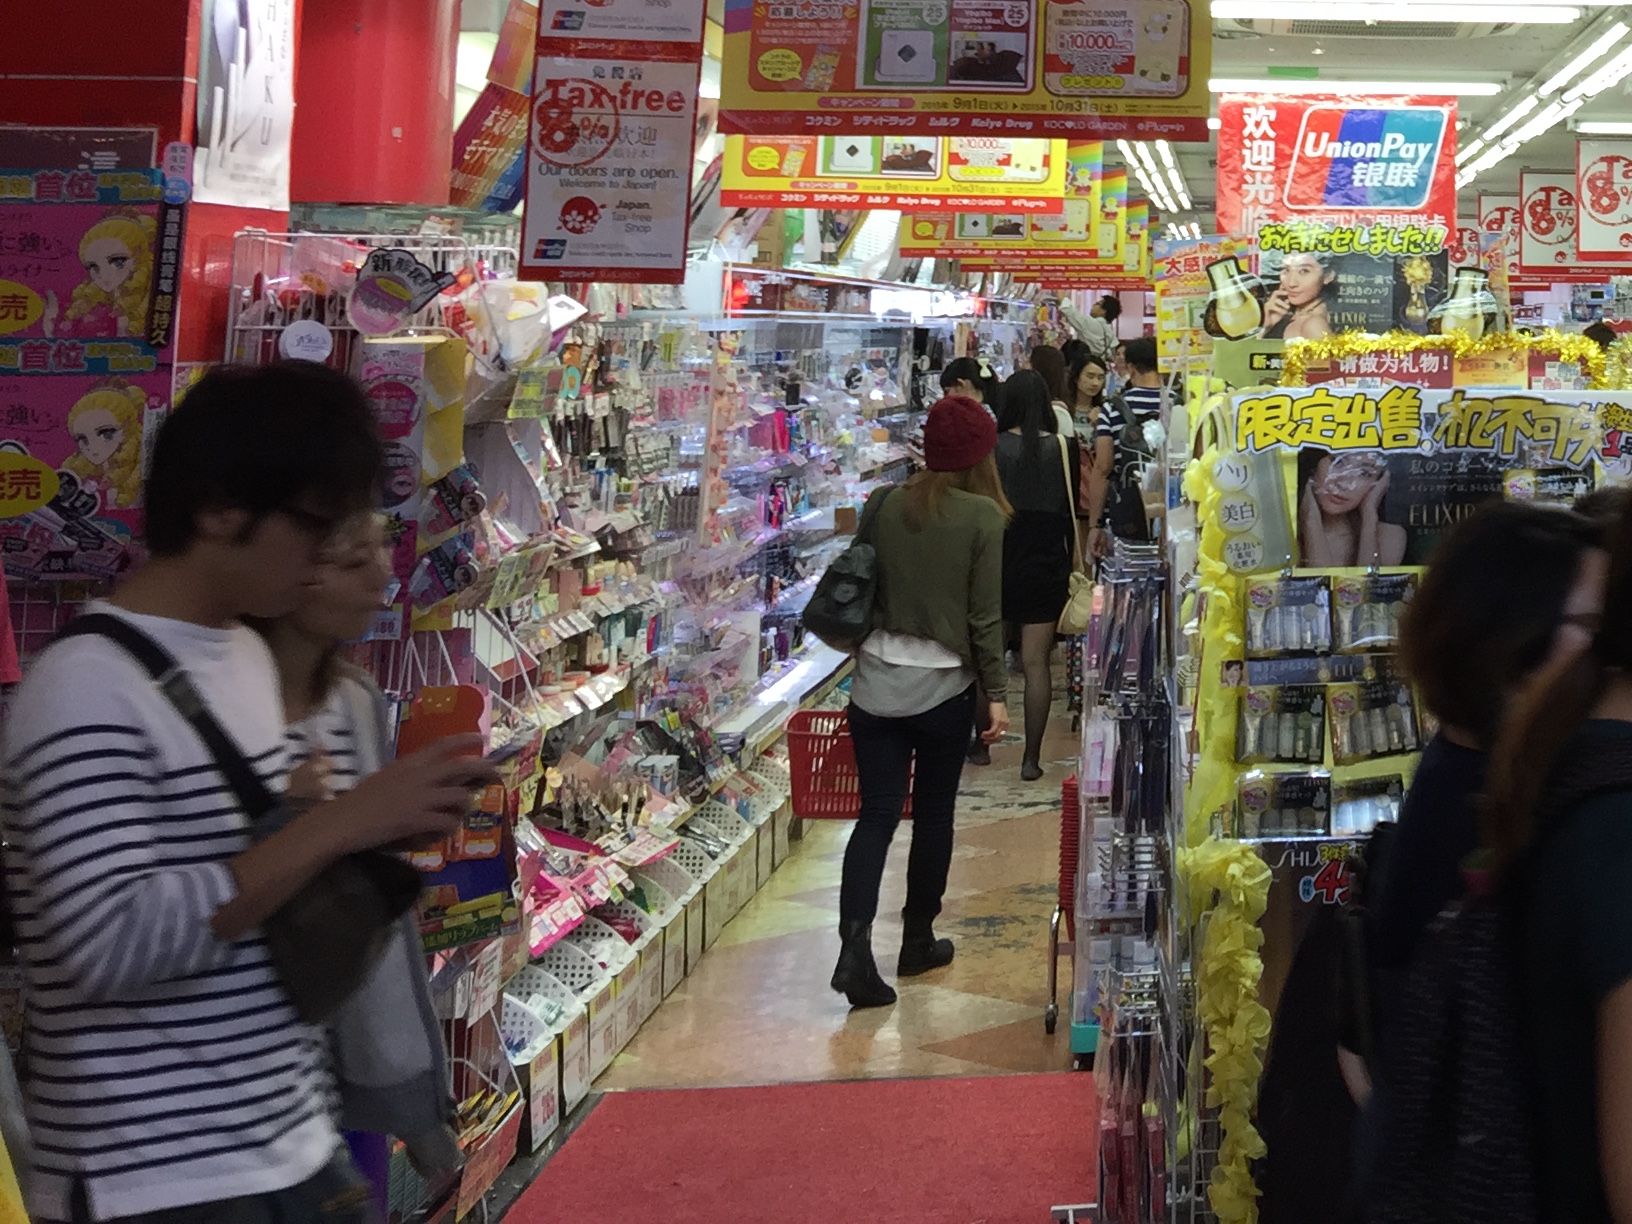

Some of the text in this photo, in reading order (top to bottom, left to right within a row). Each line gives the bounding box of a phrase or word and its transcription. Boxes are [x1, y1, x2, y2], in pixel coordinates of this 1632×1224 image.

[546, 79, 685, 113] Tax-free
[1304, 132, 1433, 169] UnionPay
[1352, 162, 1419, 188] 银联
[1223, 503, 1255, 523] 美白
